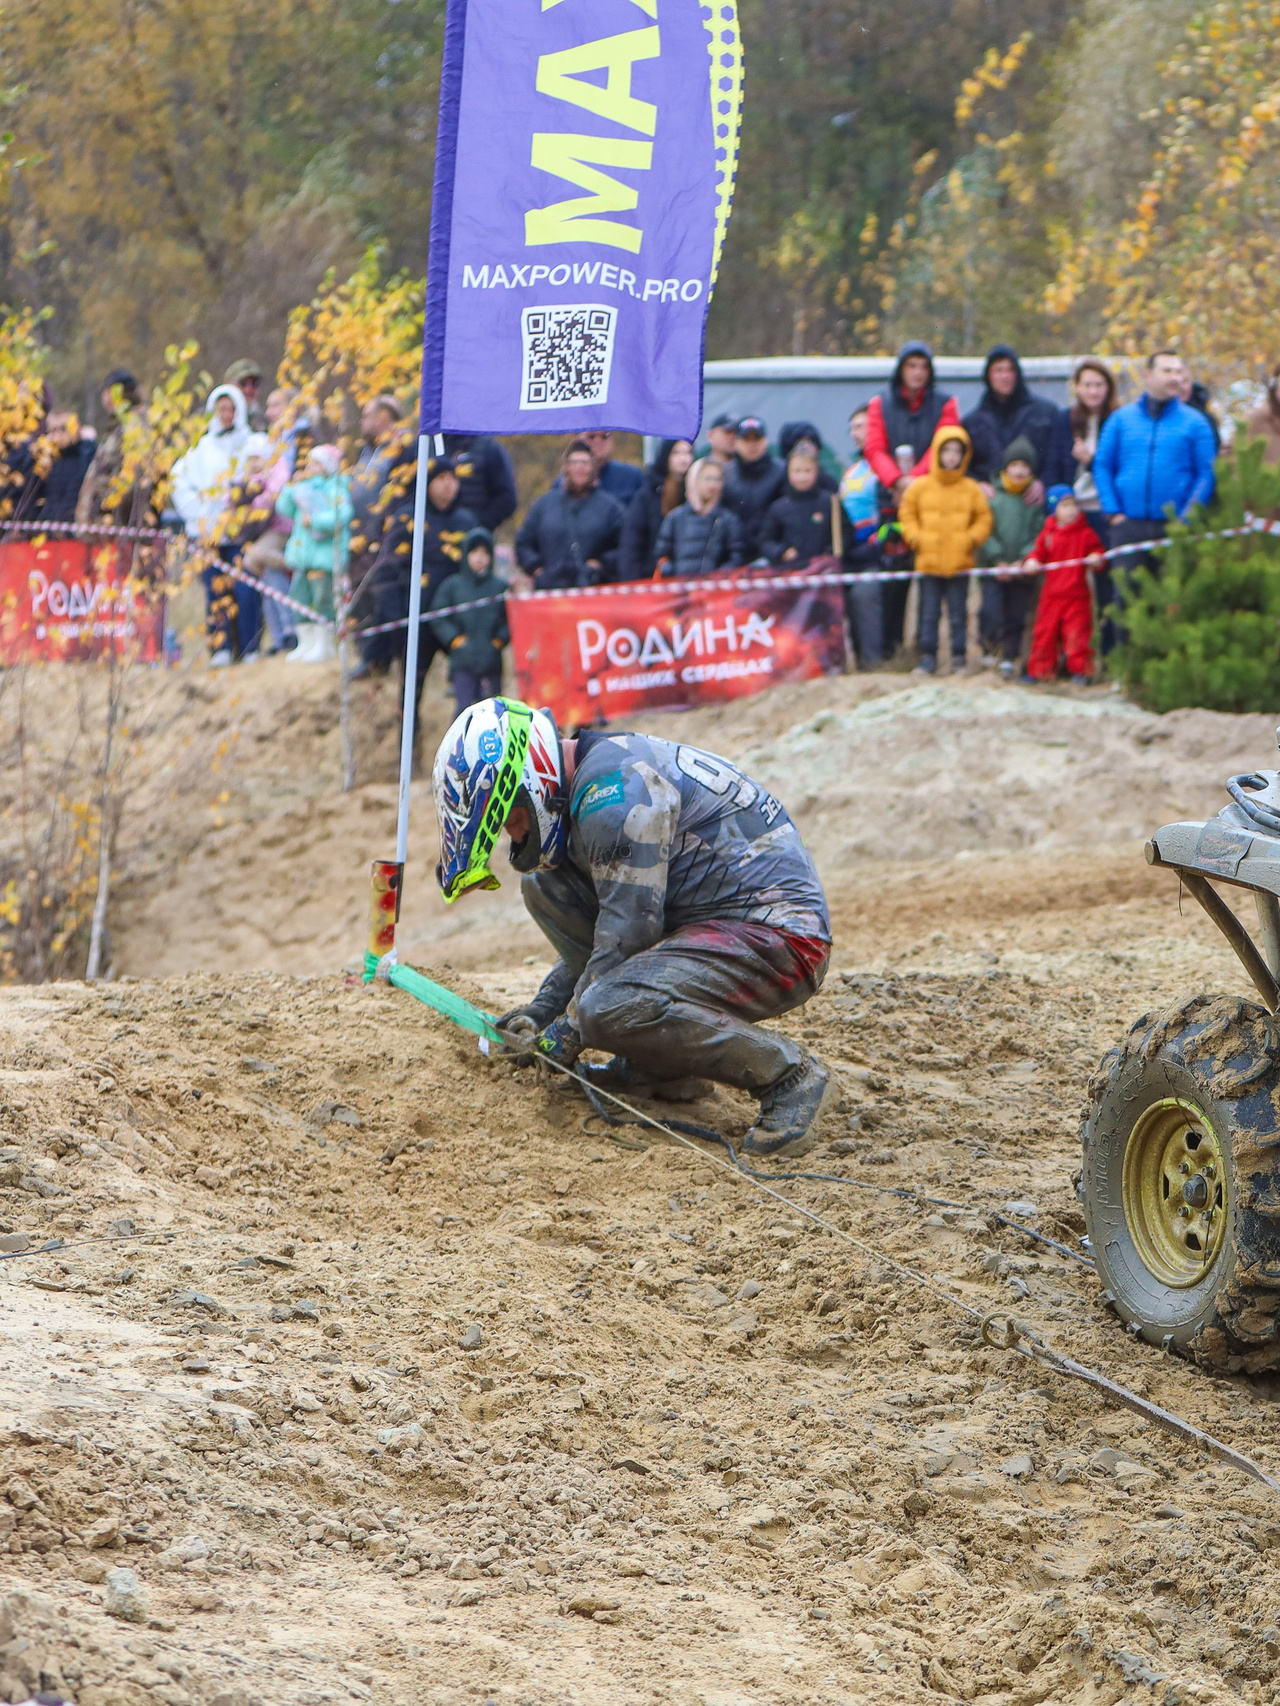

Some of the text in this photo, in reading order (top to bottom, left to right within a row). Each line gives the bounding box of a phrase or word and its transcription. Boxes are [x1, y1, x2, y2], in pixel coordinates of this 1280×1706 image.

[524, 0, 661, 255] MA
[462, 262, 703, 303] MAXPOWER.PRO
[483, 736, 496, 759] 137
